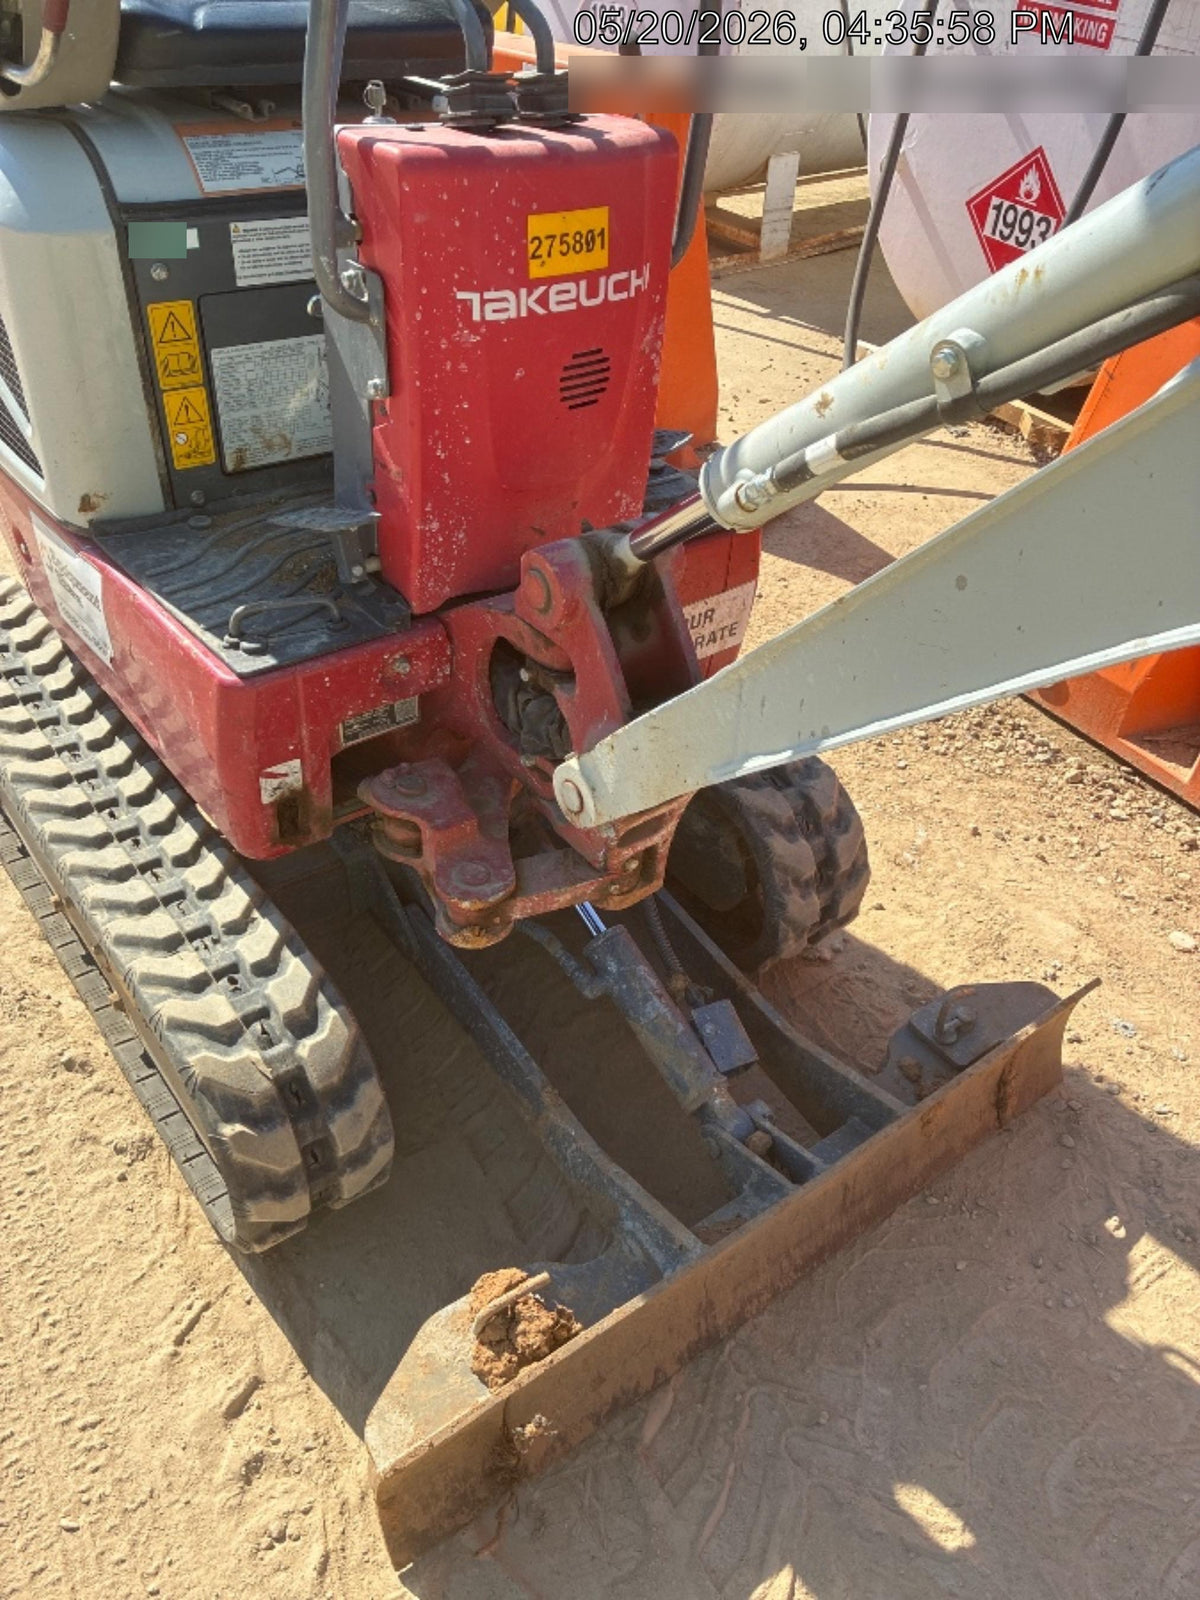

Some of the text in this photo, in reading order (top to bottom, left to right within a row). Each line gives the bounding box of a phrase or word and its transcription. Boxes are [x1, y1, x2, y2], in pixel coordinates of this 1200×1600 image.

[1042, 10, 1109, 44] MKING
[991, 200, 1052, 249] 1993
[529, 227, 607, 260] 275801
[456, 262, 650, 323] TAKEUCHI
[686, 607, 716, 630] UR
